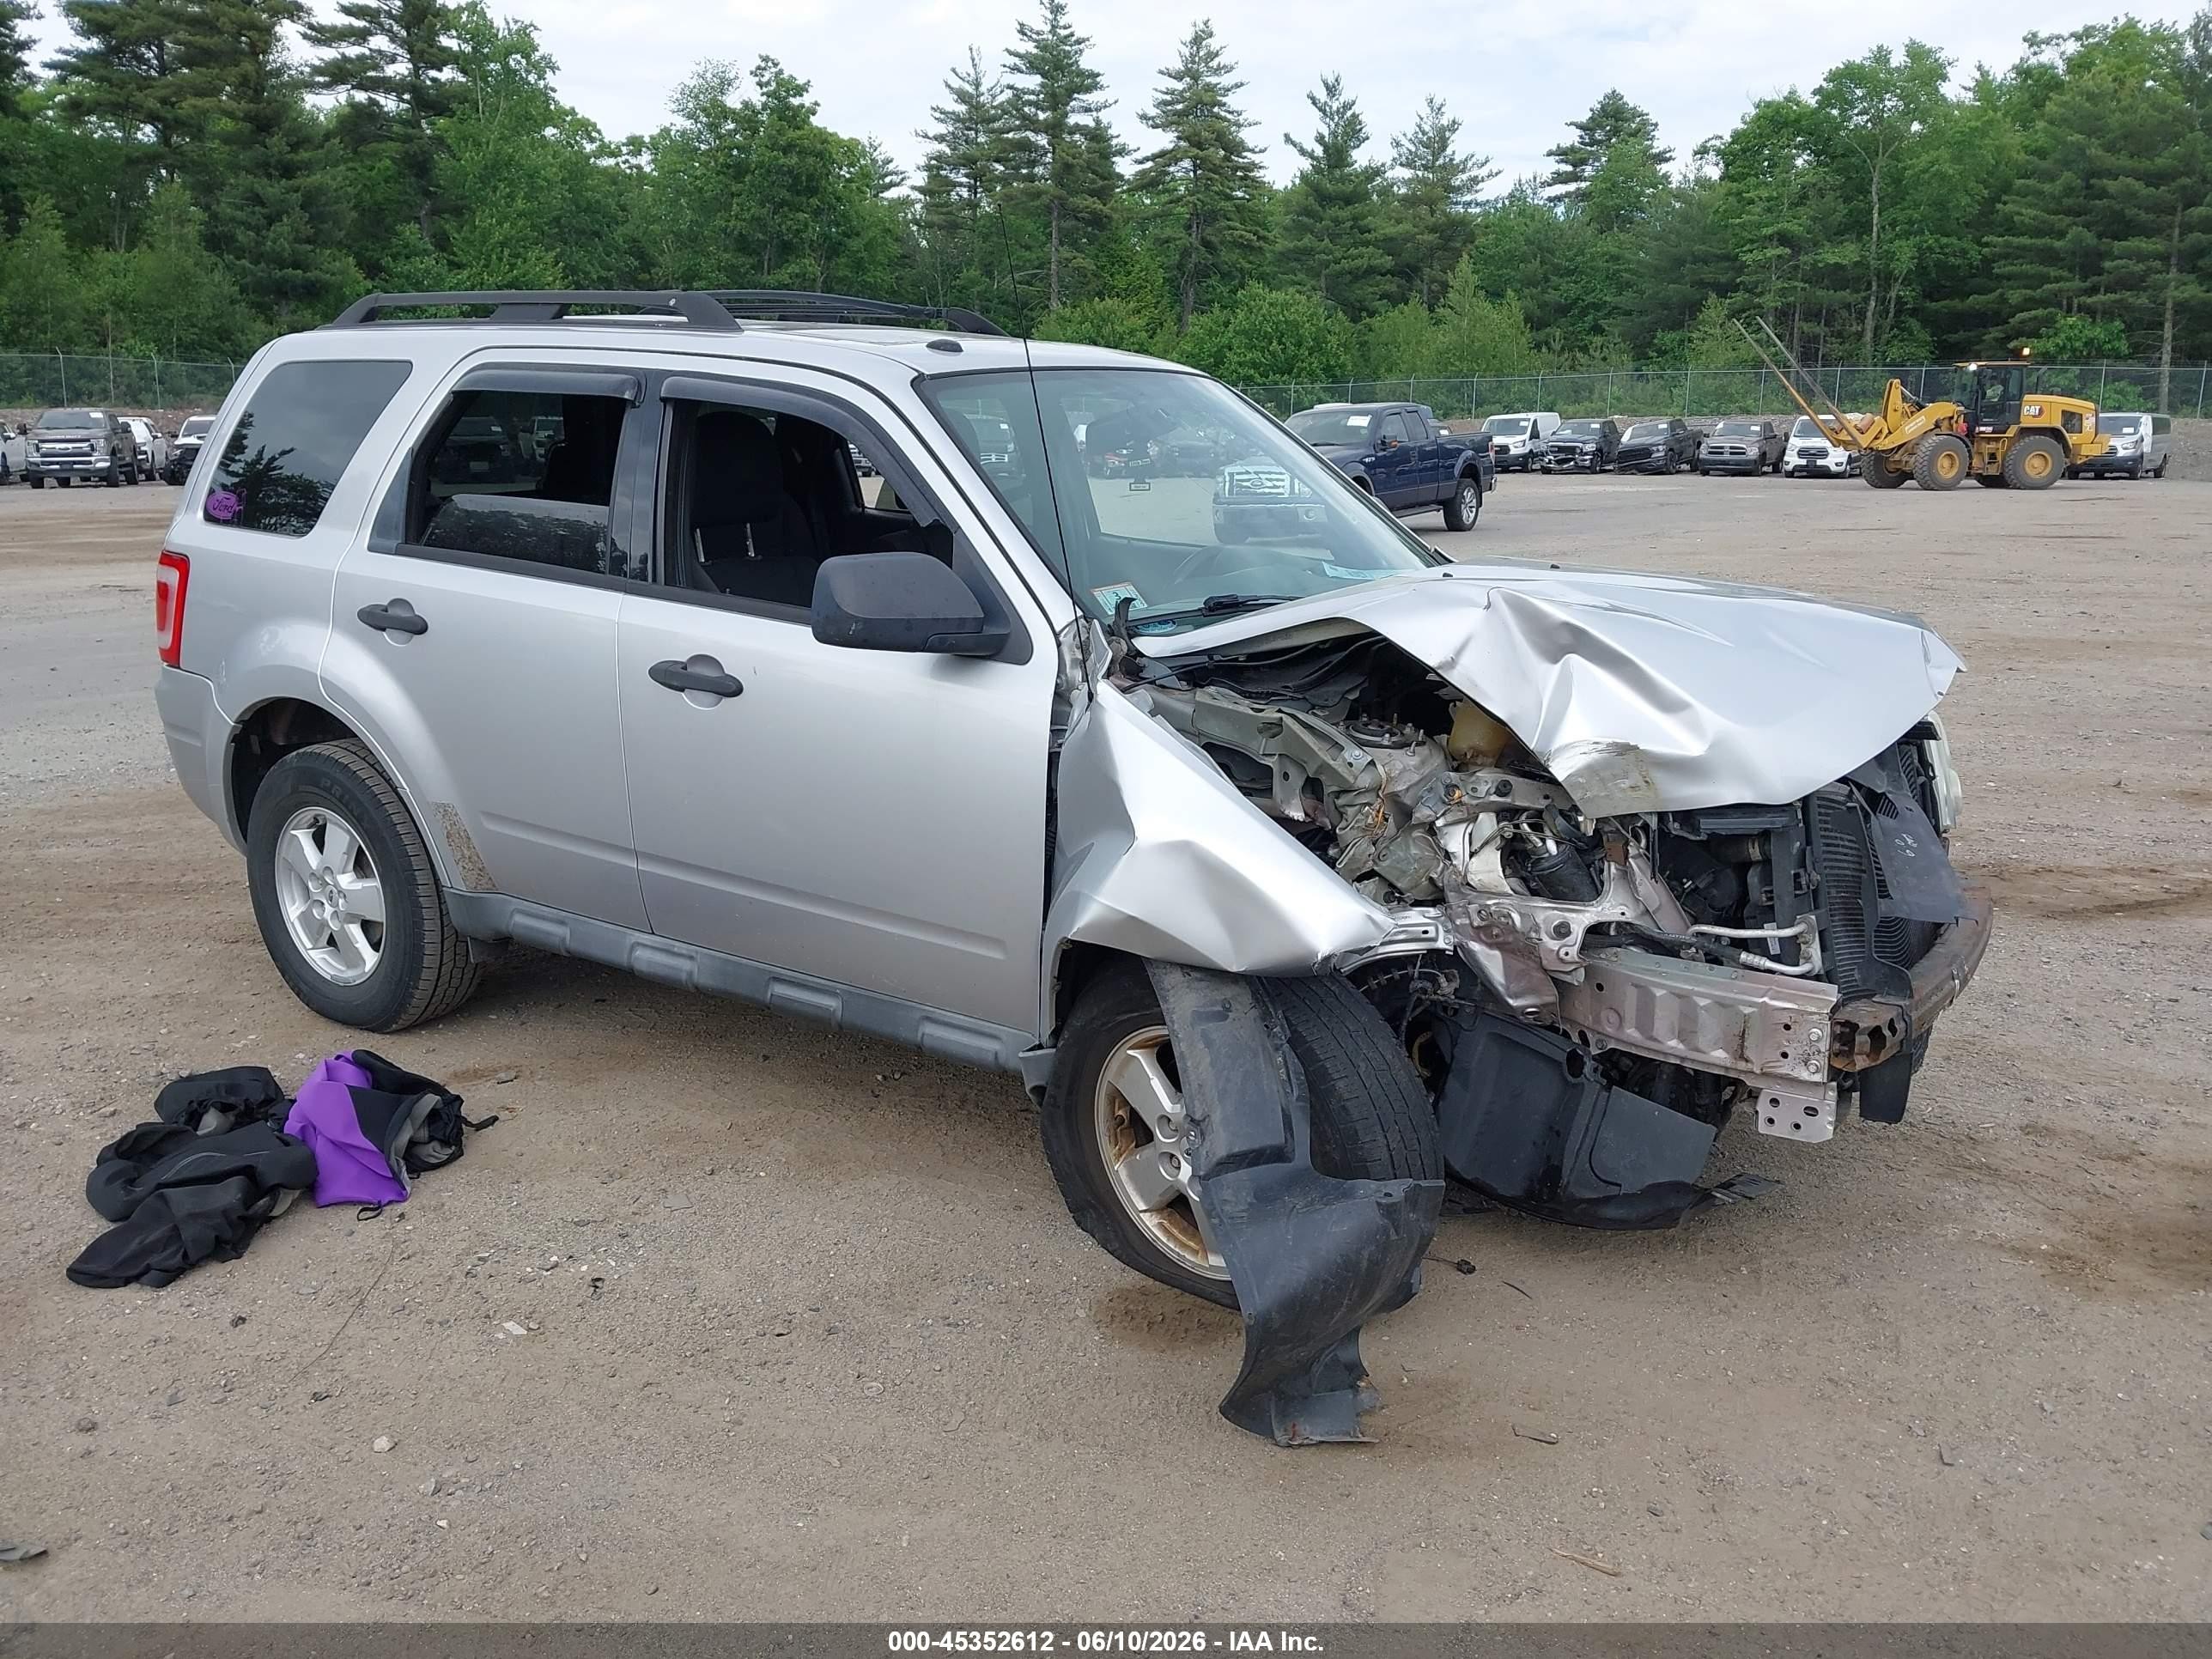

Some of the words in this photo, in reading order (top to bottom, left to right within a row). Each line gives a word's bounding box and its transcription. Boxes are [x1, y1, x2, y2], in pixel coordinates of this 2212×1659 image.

[2023, 404, 2041, 416] CAT
[212, 496, 235, 514] Ford
[1112, 592, 1122, 600] 3
